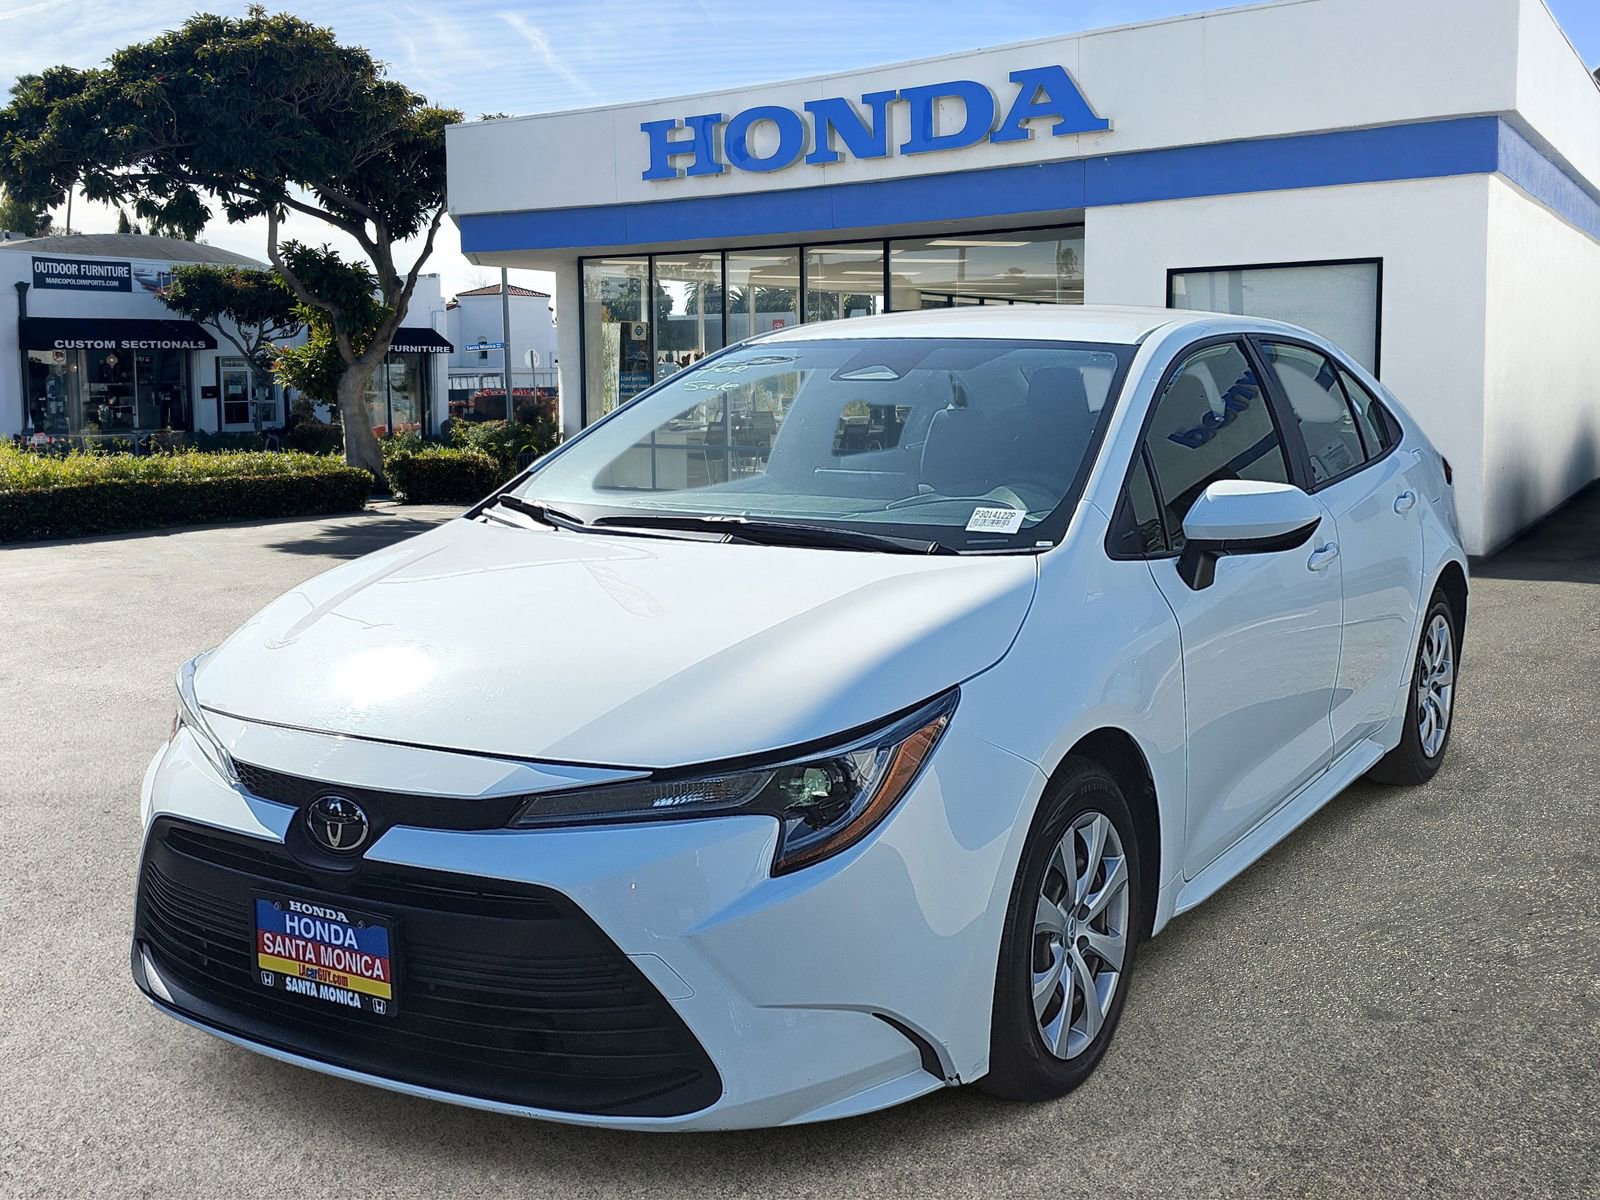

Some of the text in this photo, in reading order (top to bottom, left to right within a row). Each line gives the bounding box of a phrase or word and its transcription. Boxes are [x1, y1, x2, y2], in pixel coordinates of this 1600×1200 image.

[640, 65, 1113, 181] HONDA
[34, 261, 130, 277] OUTDOOR FURNITURE
[45, 277, 119, 287] MARCOPOLOIMPORTS.COM
[54, 339, 206, 349] CUSTOM SECTIONALS
[388, 344, 451, 353] FURNITURE
[288, 900, 350, 923] HONDA
[285, 914, 359, 949] HONDA
[263, 932, 385, 980] SANTA MONICA
[298, 963, 349, 987] LAcarGUY.com
[285, 976, 362, 1009] SANTA MONICA
